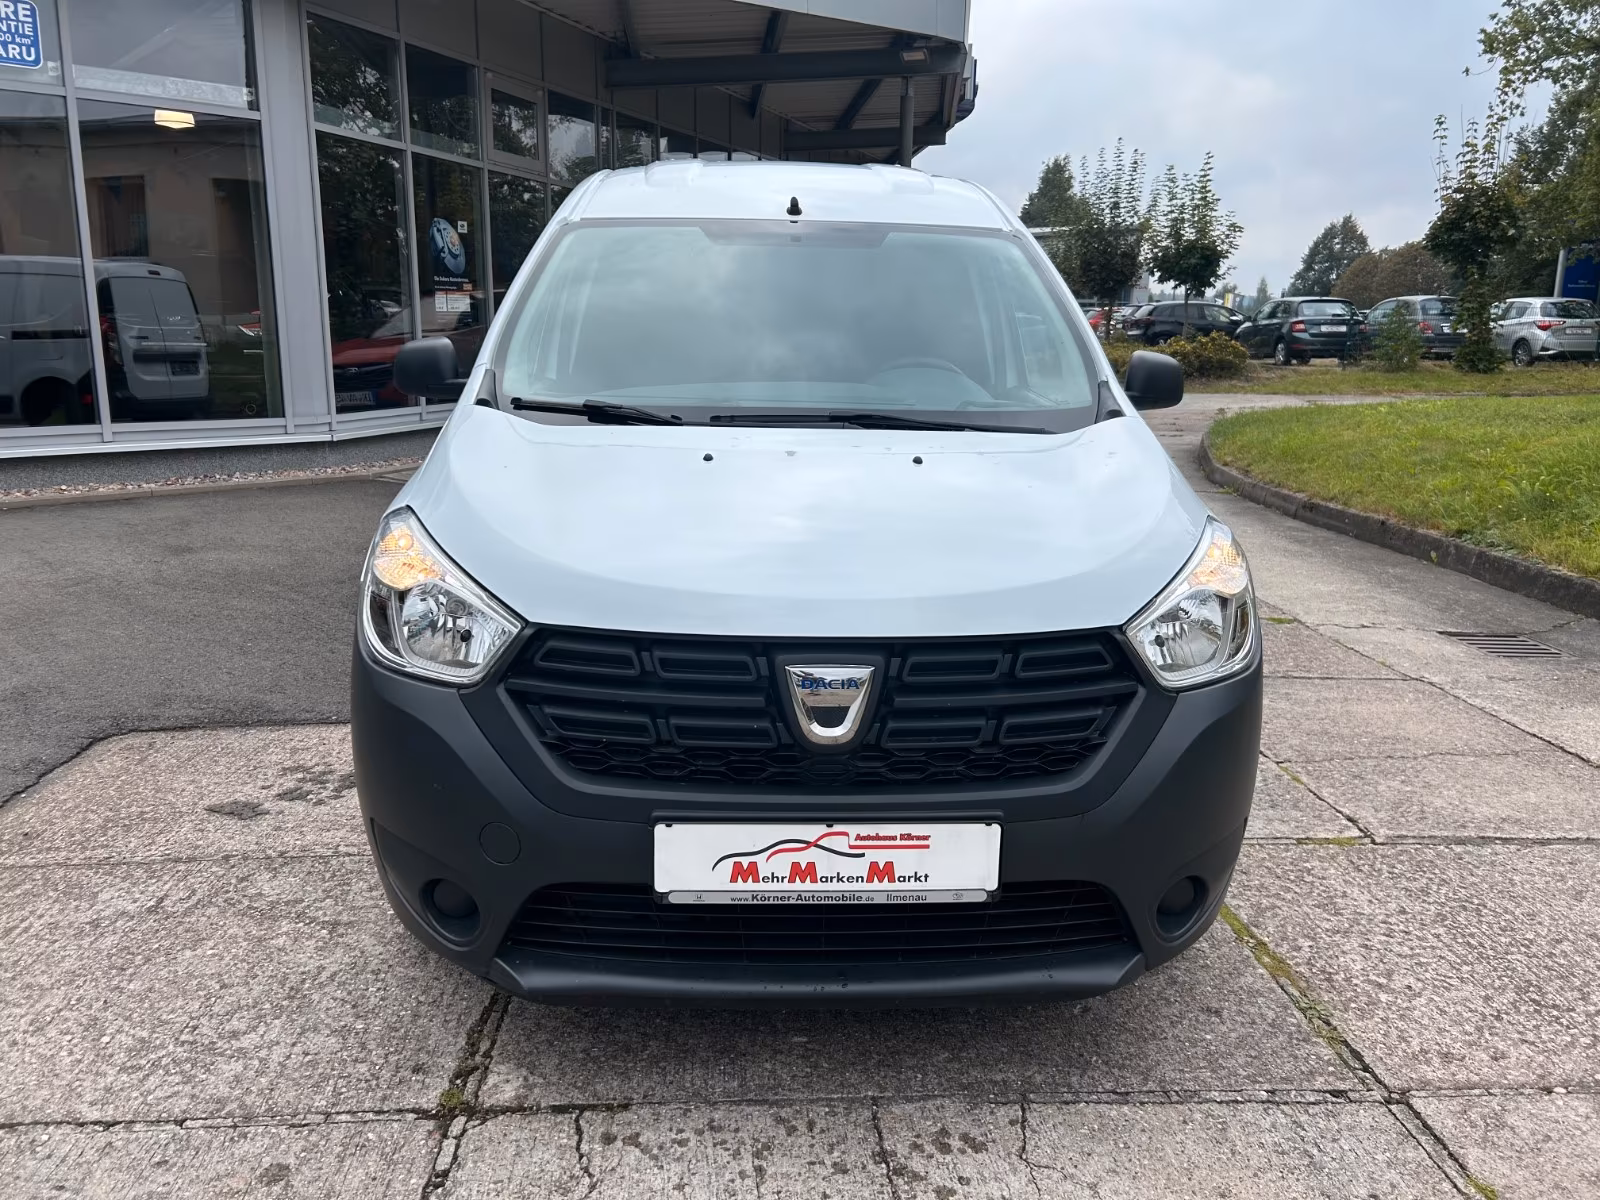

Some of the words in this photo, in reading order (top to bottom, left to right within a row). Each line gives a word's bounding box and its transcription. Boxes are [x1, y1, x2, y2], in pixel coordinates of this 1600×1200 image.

[0, 1, 33, 22] RE
[801, 679, 860, 690] DACIA
[854, 833, 898, 842] Autohaus
[899, 833, 931, 842] Körner
[730, 893, 875, 903] www.Körner-Automobile.de
[886, 893, 927, 902] Ilmenau
